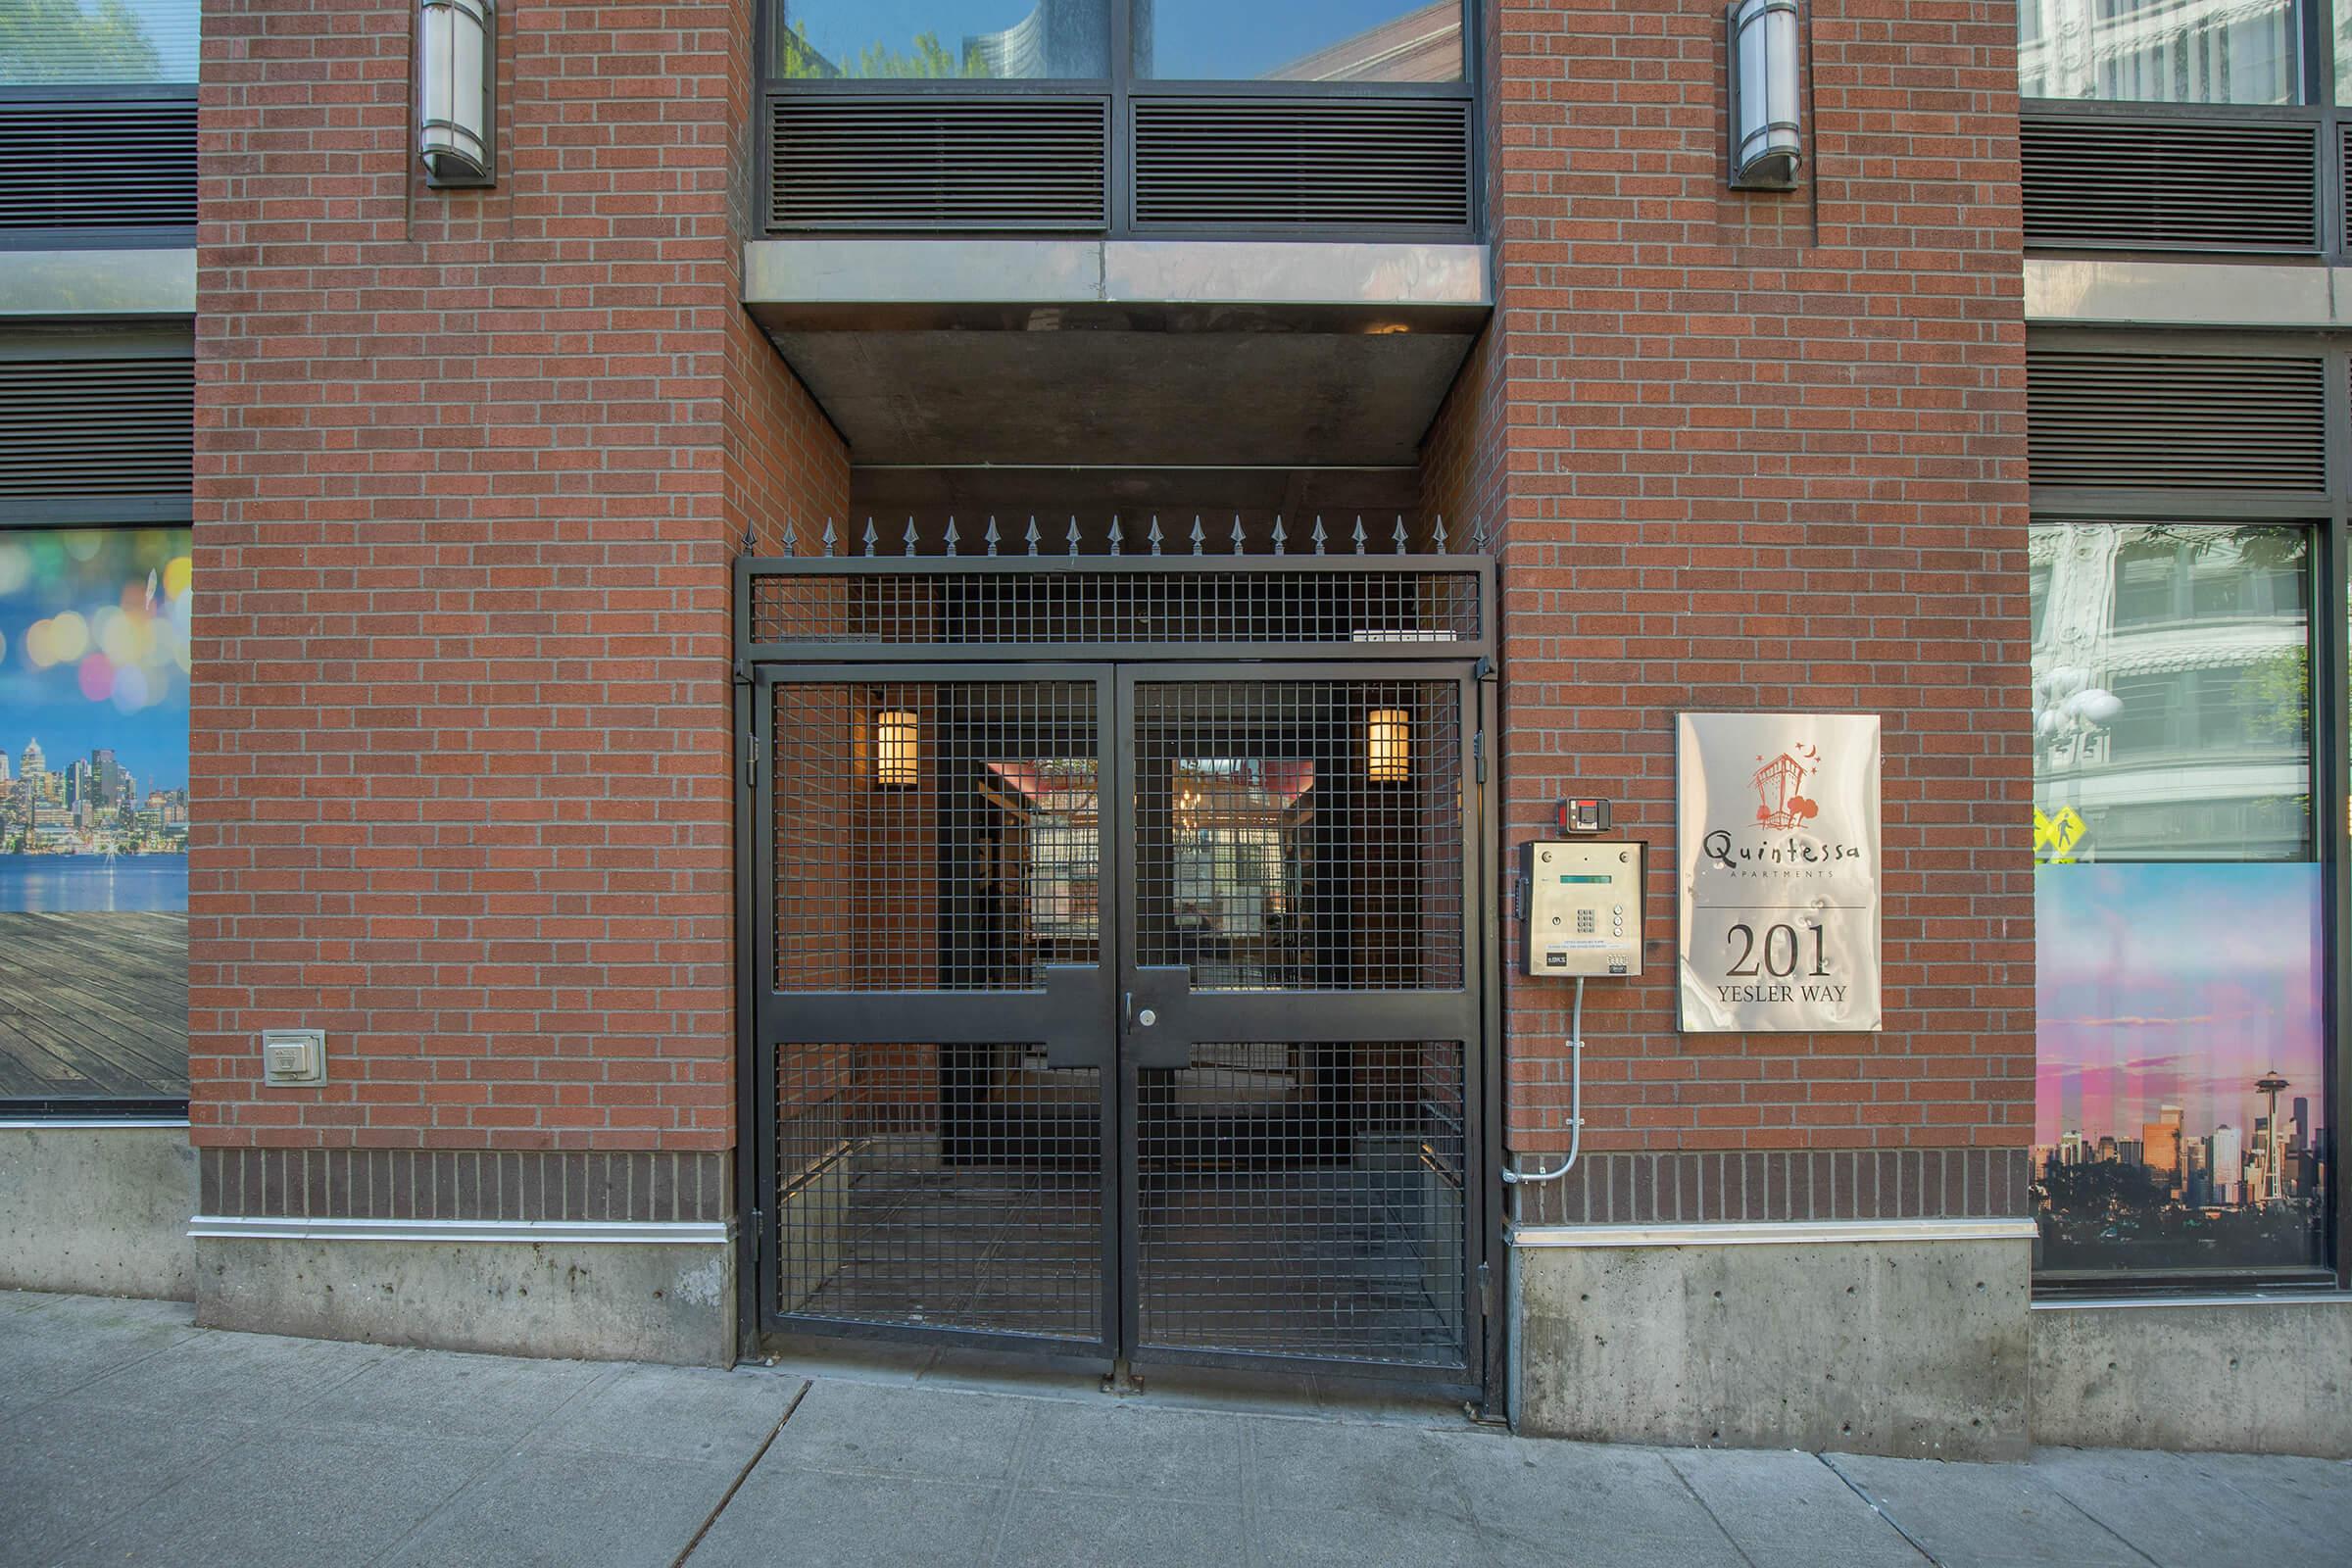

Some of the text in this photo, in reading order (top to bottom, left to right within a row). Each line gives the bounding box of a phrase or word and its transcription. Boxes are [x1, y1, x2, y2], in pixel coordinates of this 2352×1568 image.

[1703, 830, 1860, 868] Quintessa
[1726, 924, 1831, 977] 201
[1717, 985, 1846, 1003] YESLER WAY
